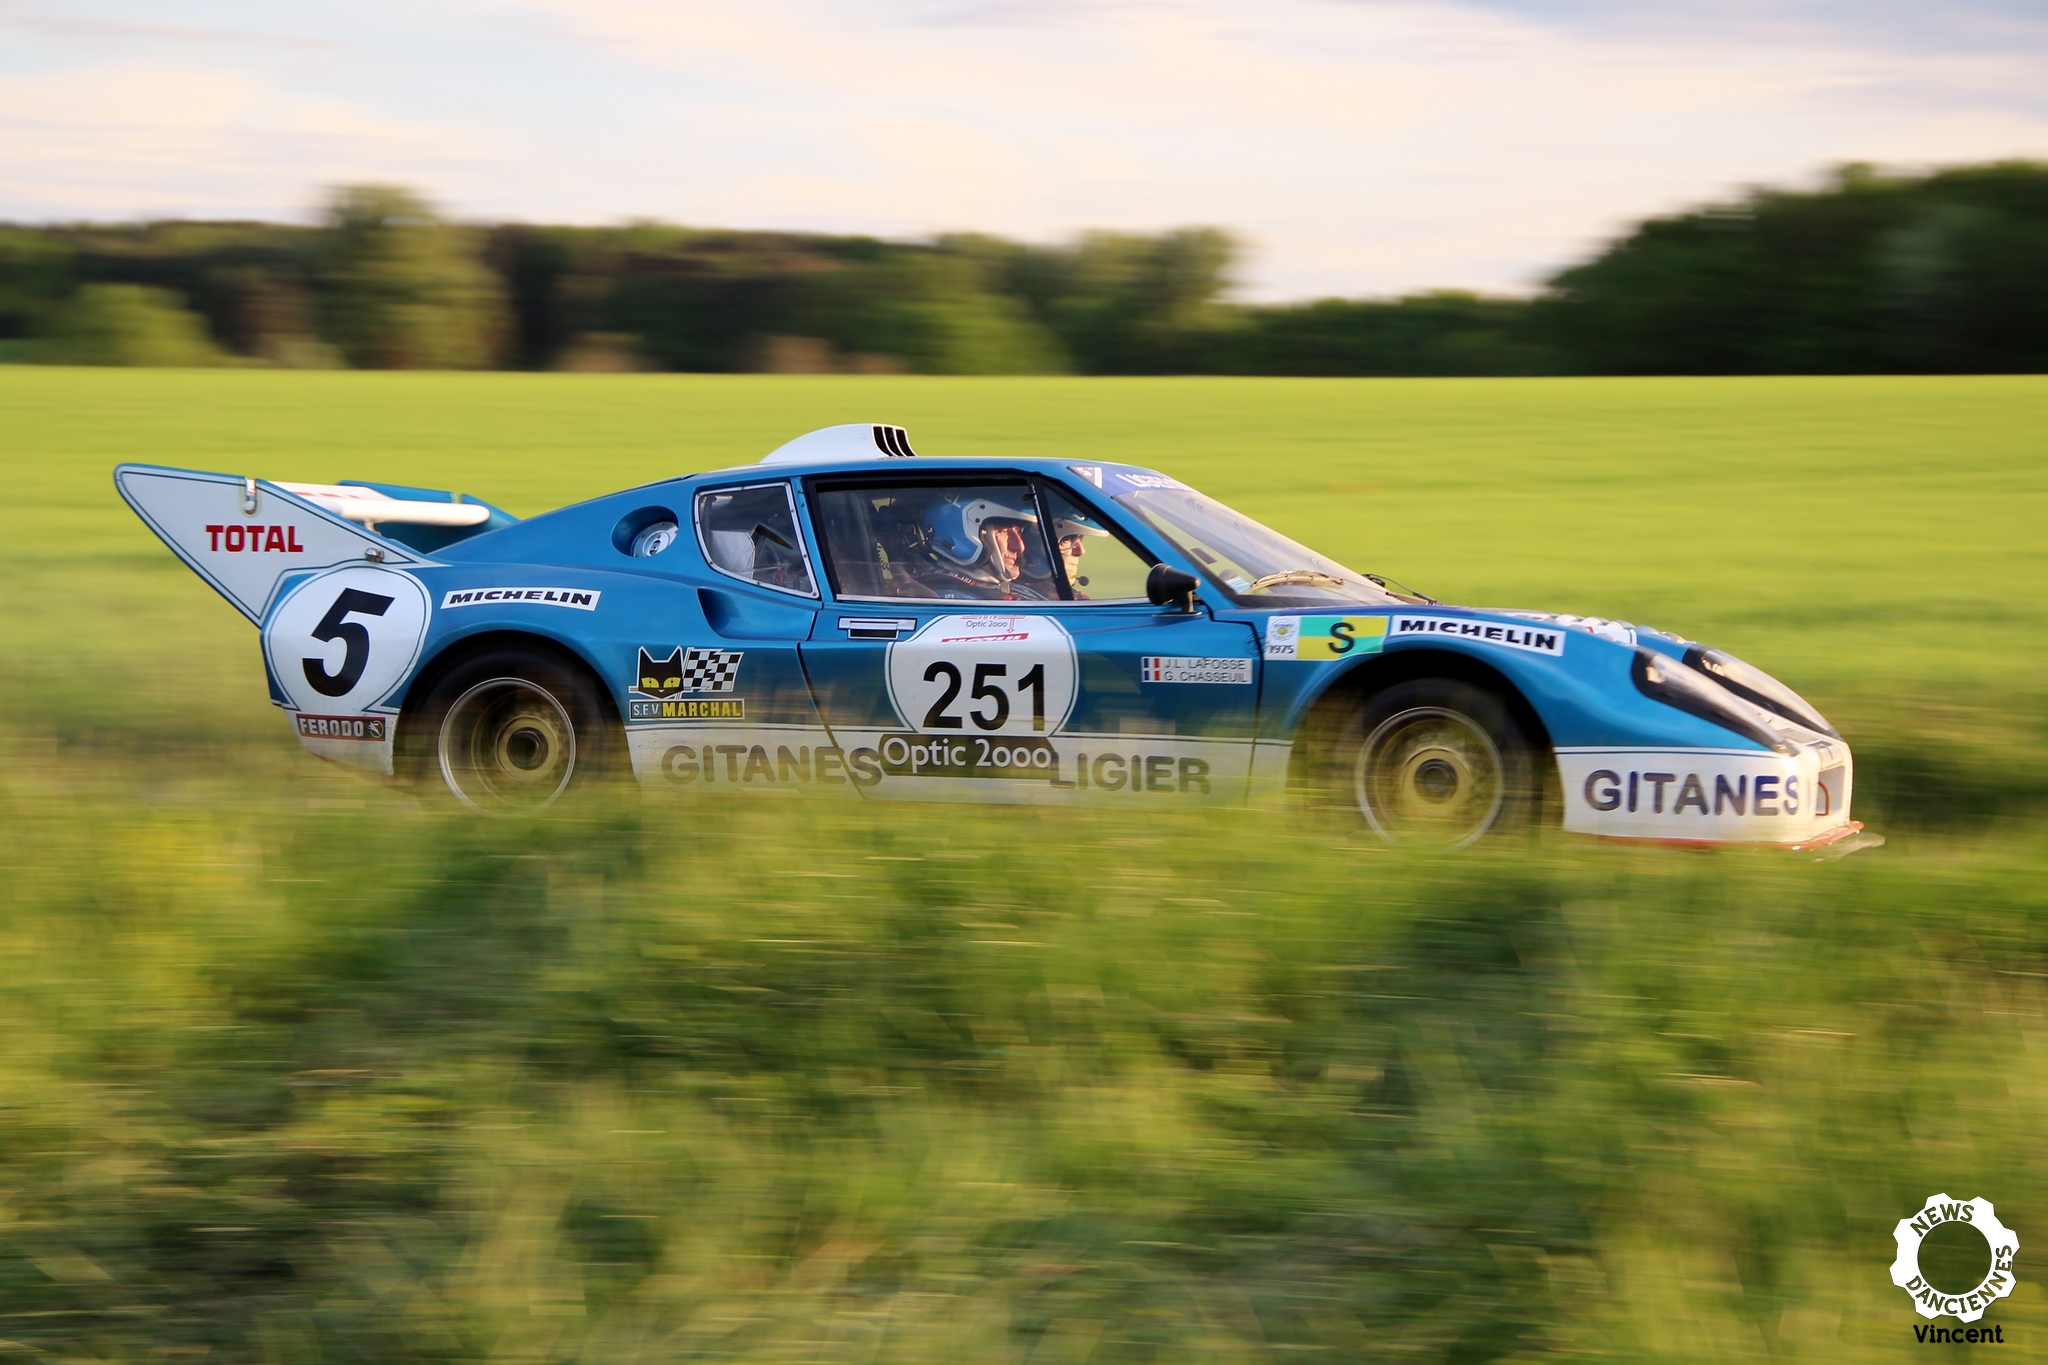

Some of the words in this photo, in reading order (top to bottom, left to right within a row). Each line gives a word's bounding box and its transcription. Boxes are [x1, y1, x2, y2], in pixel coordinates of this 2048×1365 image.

[206, 525, 303, 553] TOTAL
[449, 589, 593, 606] MICHELIN
[966, 620, 987, 628] Optic
[1328, 622, 1355, 653] S
[1400, 620, 1557, 650] MICHELIN
[302, 587, 395, 697] 5
[1268, 645, 1294, 654] 1975
[1164, 671, 1177, 681] G.
[1180, 672, 1247, 683] CHASSEUIL
[1189, 660, 1246, 670] LAFOSSE
[662, 702, 741, 717] MARCHAL
[922, 661, 1045, 732] 251
[299, 717, 364, 737] FERODO
[661, 744, 883, 788] GITANES
[883, 738, 967, 774] Optic
[976, 739, 1052, 769] 2000
[1049, 752, 1211, 795] LIGIER
[1584, 769, 1799, 817] GITANES
